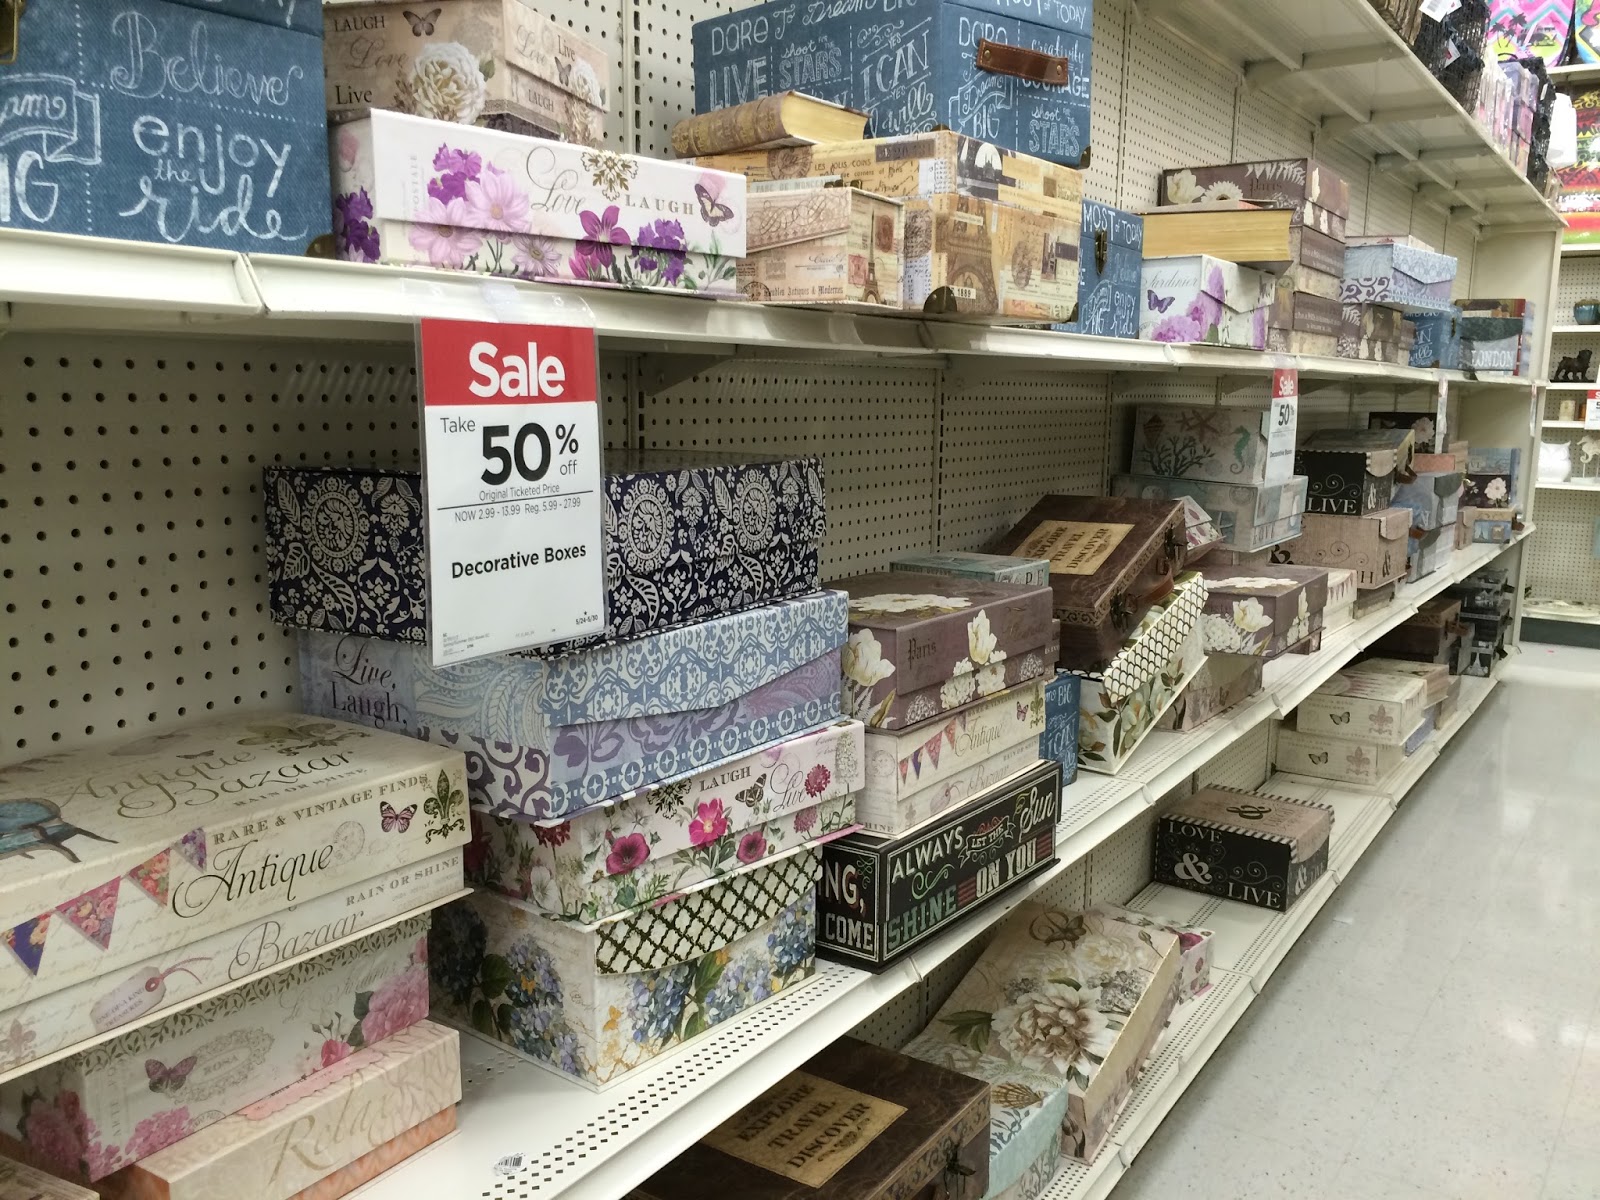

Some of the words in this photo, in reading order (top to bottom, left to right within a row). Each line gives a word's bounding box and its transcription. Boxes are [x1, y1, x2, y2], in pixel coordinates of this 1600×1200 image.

[334, 16, 385, 32] LAUGH
[110, 10, 303, 105] Believe
[557, 35, 576, 61] Live
[779, 48, 843, 89] STARS
[875, 30, 931, 92] CAN
[335, 85, 373, 105] Live
[973, 103, 1000, 139] BIG
[1029, 119, 1080, 157] STARS
[132, 115, 292, 198] enjoy
[154, 159, 193, 183] the
[119, 173, 308, 243] ride
[625, 193, 694, 215] LAUGH
[1083, 203, 1116, 241] MOST
[468, 341, 566, 398] Sale
[1471, 350, 1514, 367] LONDON
[1279, 375, 1294, 396] Sale
[440, 416, 476, 433] Take
[559, 460, 578, 476] off
[454, 511, 476, 523] NOW
[478, 508, 496, 519] 2.99
[502, 504, 521, 517] 13.99
[524, 503, 541, 515] Reg.
[542, 499, 558, 512] 5.99
[563, 497, 581, 509] 27.99
[479, 487, 508, 502] Original
[510, 485, 541, 498] Ticketed
[542, 483, 560, 494] Price
[1307, 497, 1357, 514] LIVE
[451, 552, 540, 579] Decorative
[544, 544, 587, 563] Boxes
[331, 633, 396, 693] Live,
[908, 638, 937, 670] Paris
[330, 680, 408, 729] Laugh,
[58, 750, 256, 808] Antique
[117, 750, 353, 818] Bazaar
[700, 766, 751, 792] LAUGH
[213, 819, 269, 846] RARE
[275, 814, 286, 827] &
[293, 790, 373, 821] VINTAGE
[379, 774, 428, 796] FINDS
[1019, 786, 1055, 842] Sun
[971, 835, 986, 847] LET
[988, 826, 1005, 842] THE
[1168, 821, 1223, 844] LOVE
[892, 826, 964, 884] ALWAYS
[976, 862, 1001, 898] ON
[1005, 838, 1037, 880] YOU
[1174, 852, 1213, 885] &
[172, 840, 334, 918] Antique
[346, 883, 384, 906] RAIN
[390, 875, 410, 889] OR
[414, 856, 459, 881] SHINE
[1227, 882, 1282, 909] LIVE
[887, 884, 957, 951] SHINE
[228, 910, 364, 981] Bazaar
[768, 1100, 836, 1150] TRAVEL
[787, 1102, 871, 1169] DISCOVER
